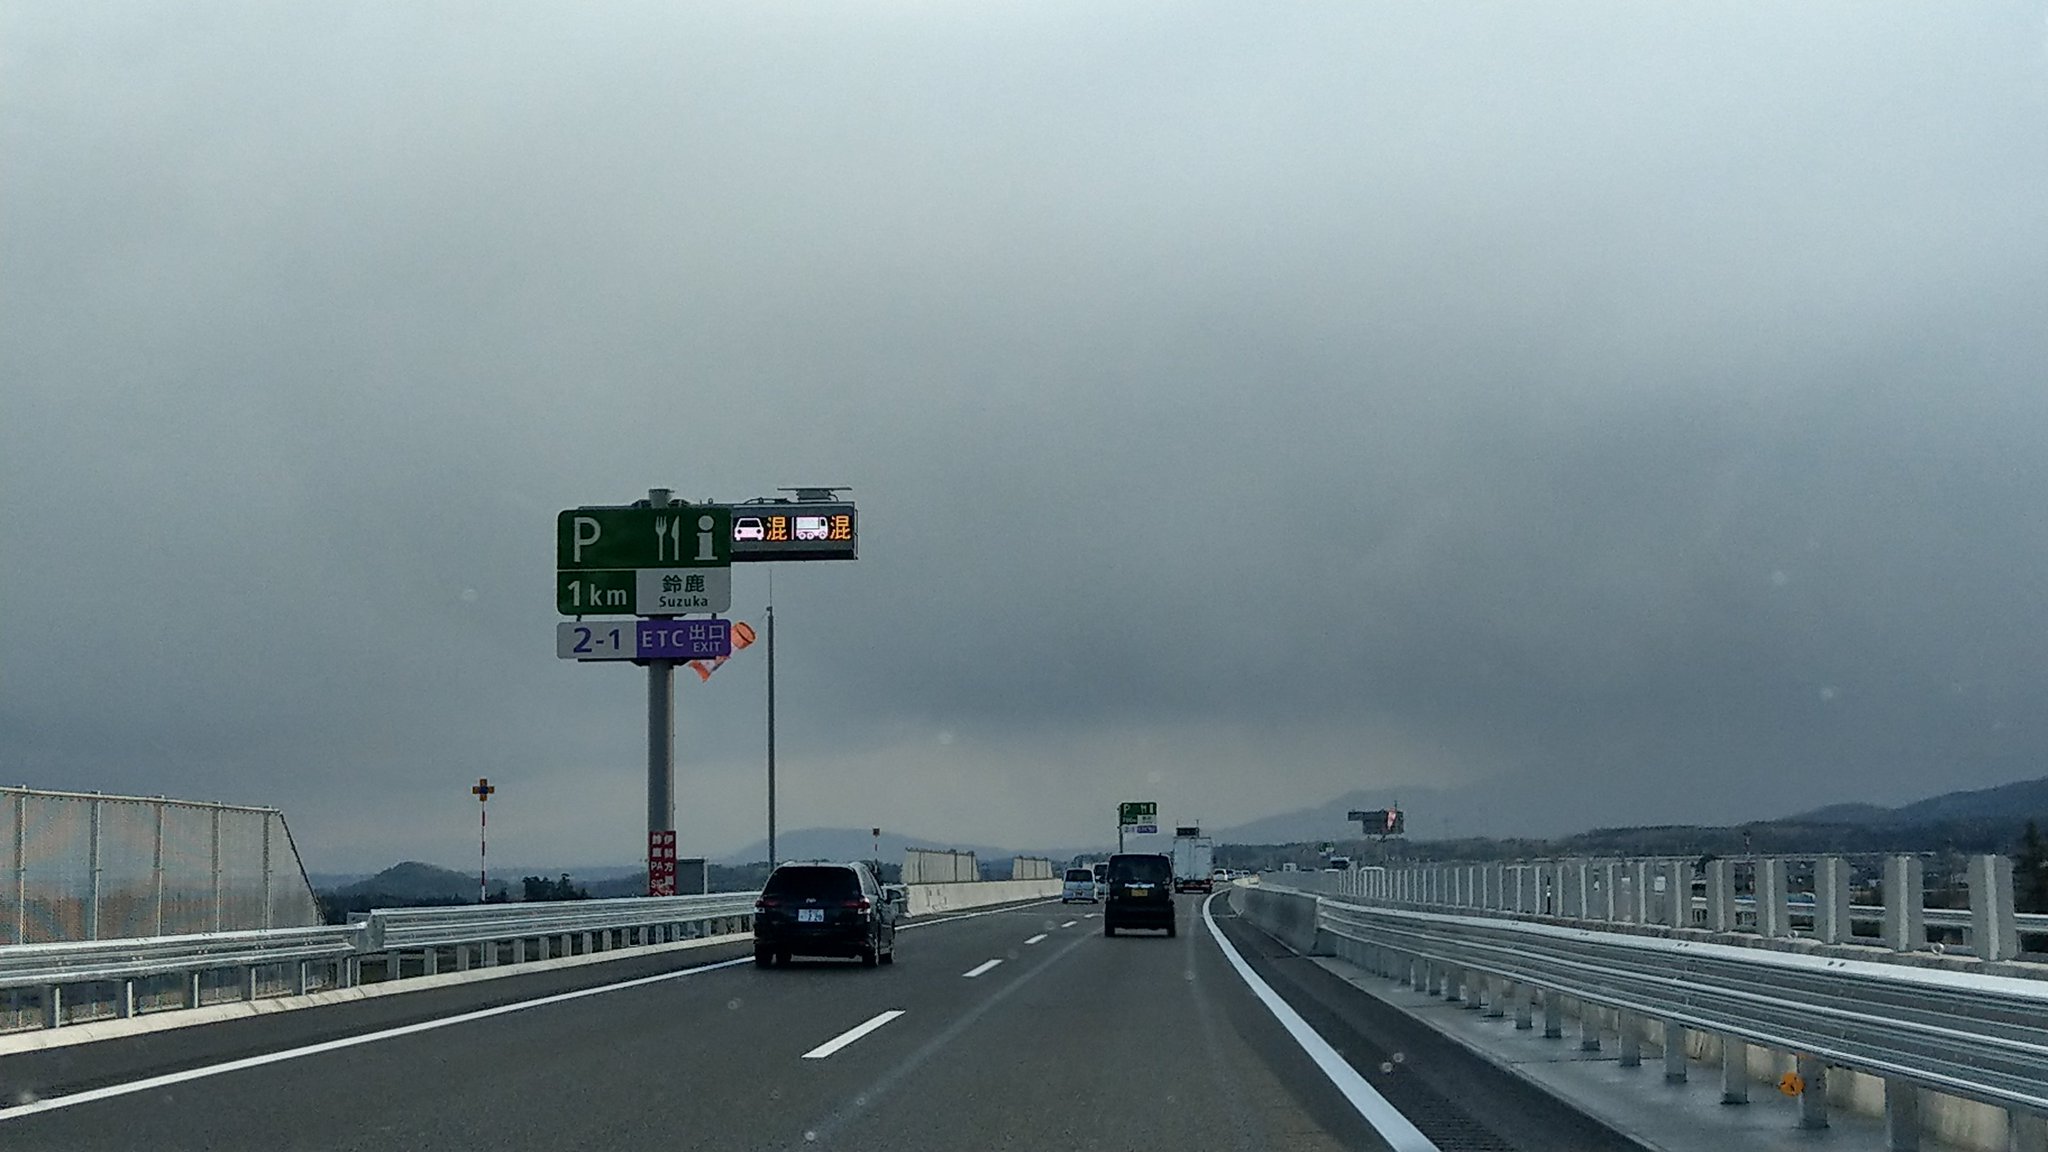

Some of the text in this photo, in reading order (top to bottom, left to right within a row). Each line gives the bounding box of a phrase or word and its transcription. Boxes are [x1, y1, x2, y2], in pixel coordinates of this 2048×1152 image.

[766, 516, 788, 541] 混
[831, 515, 851, 540] 混
[573, 517, 601, 563] P
[662, 575, 705, 593] 鈴鹿
[659, 596, 708, 608] Suzuka
[573, 628, 620, 653] 2-1
[642, 625, 725, 648] ETC 出口
[693, 642, 721, 653] EXIT
